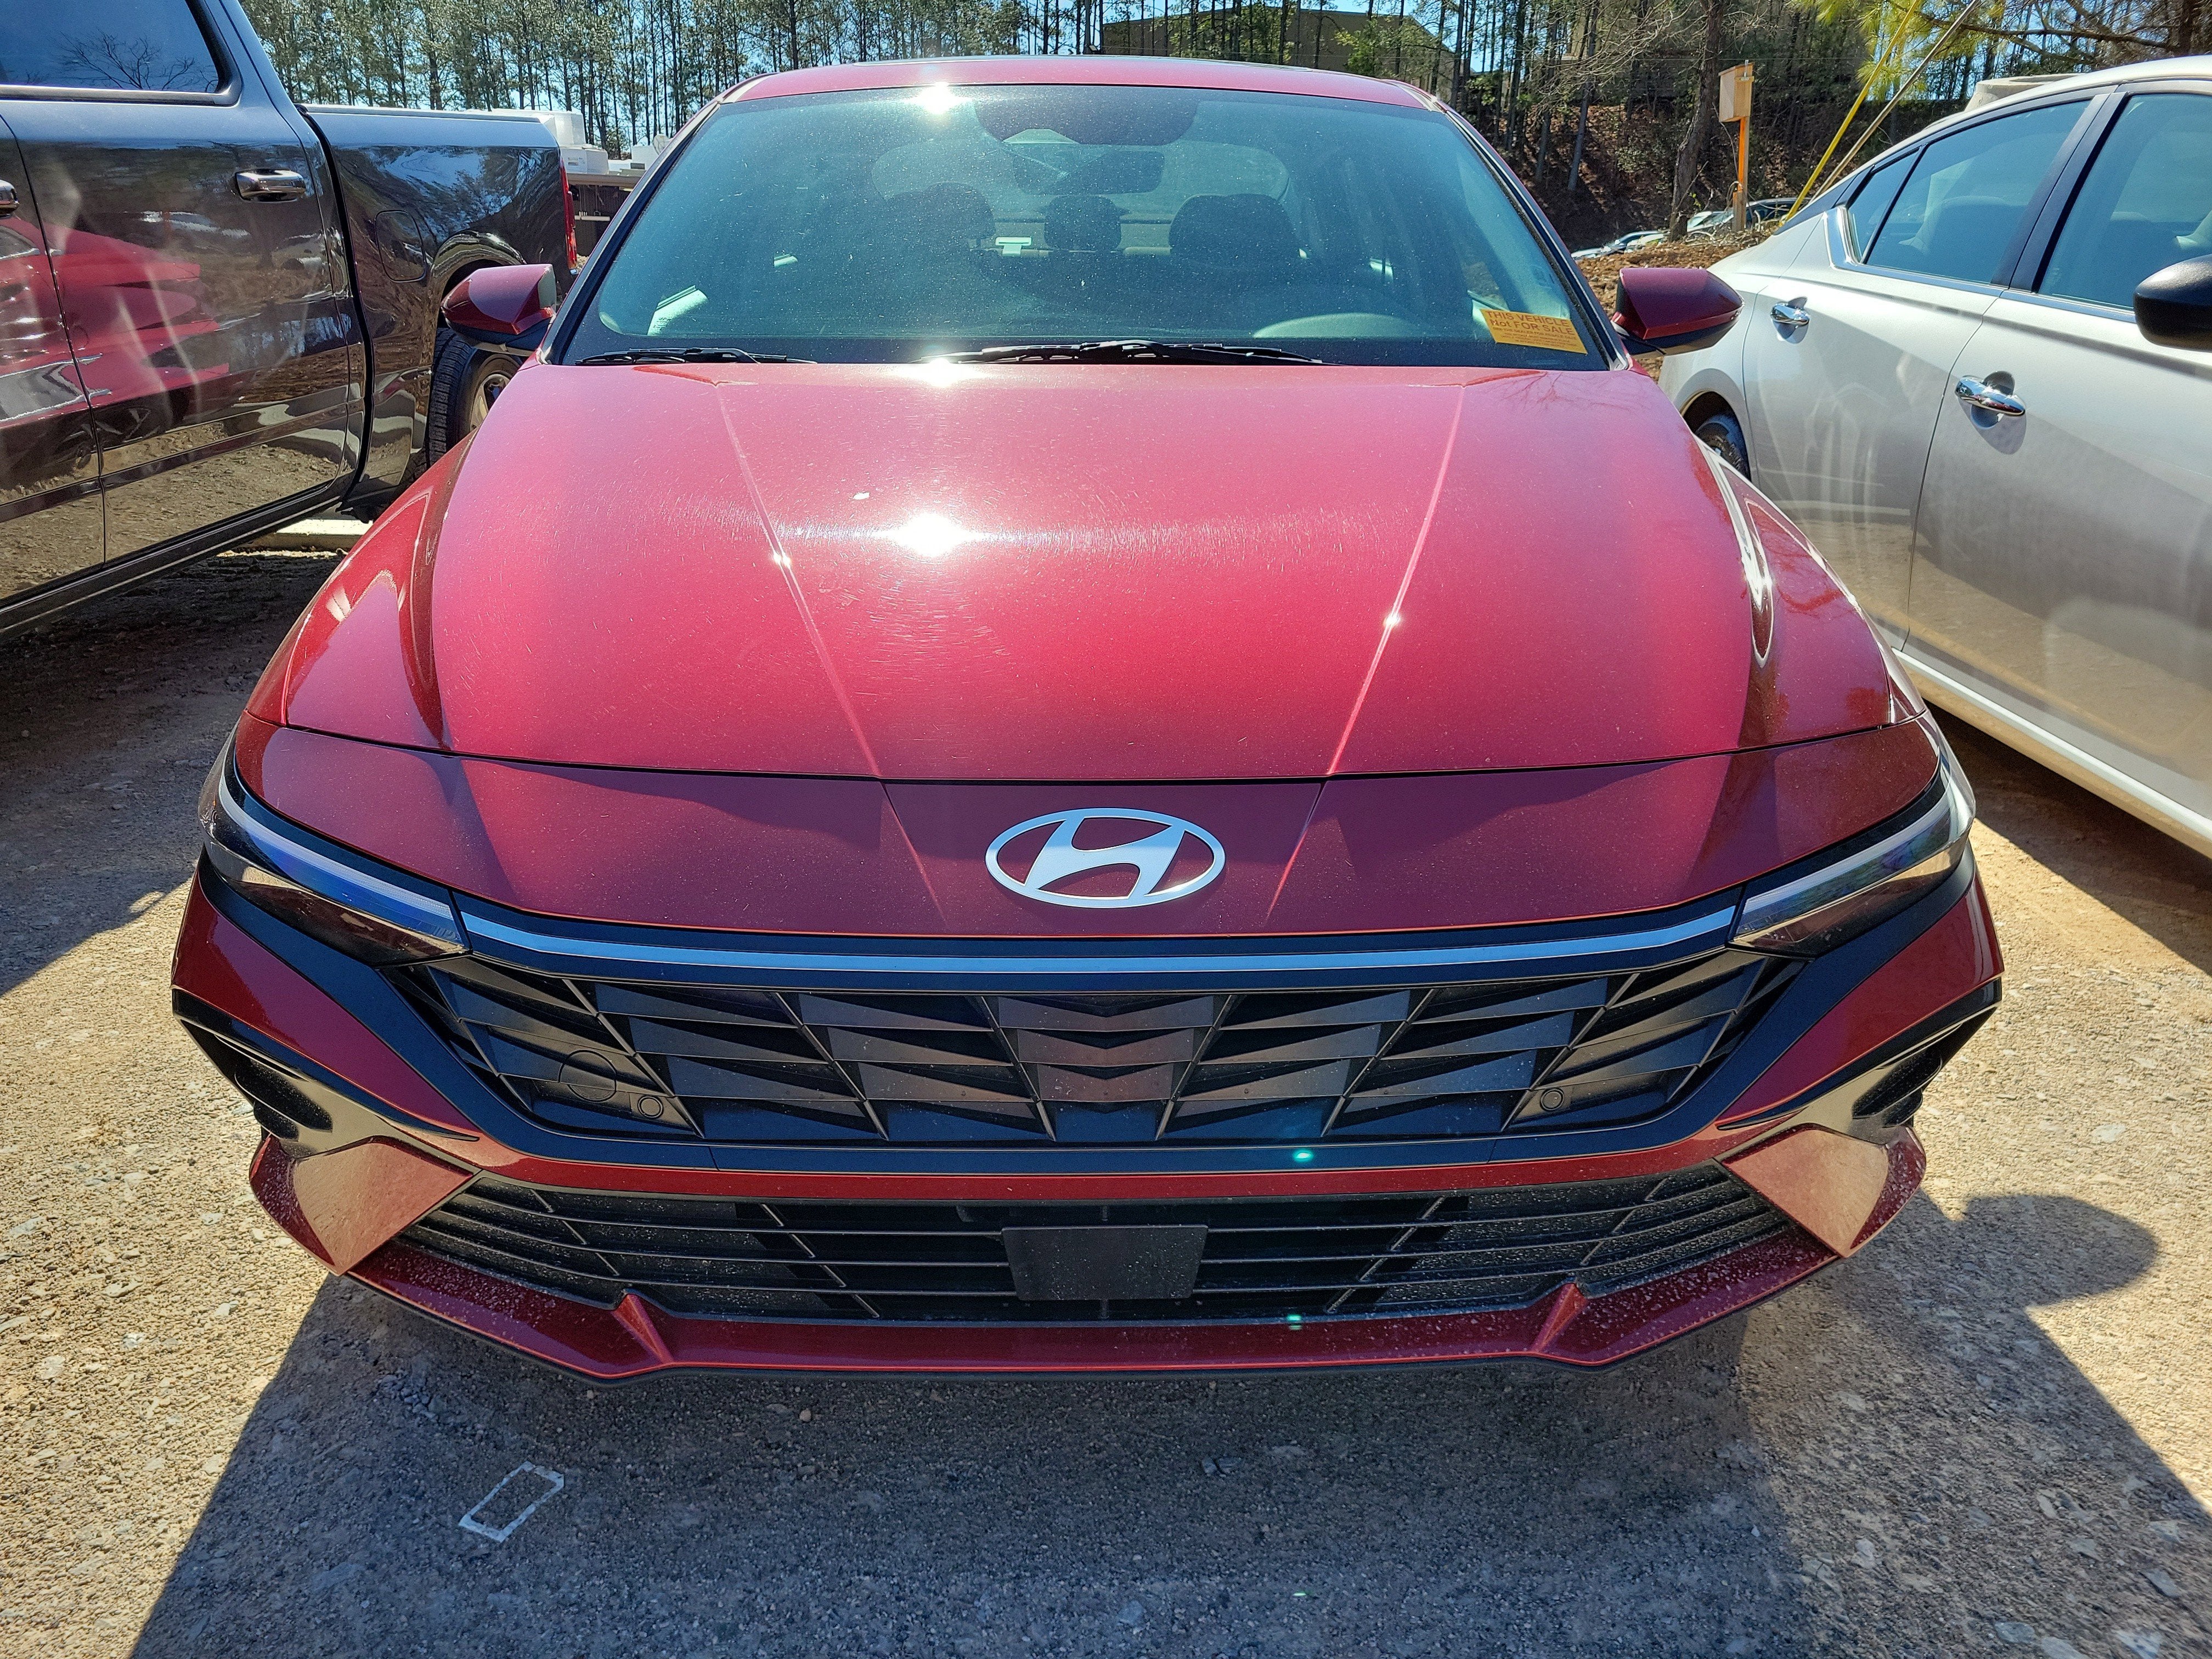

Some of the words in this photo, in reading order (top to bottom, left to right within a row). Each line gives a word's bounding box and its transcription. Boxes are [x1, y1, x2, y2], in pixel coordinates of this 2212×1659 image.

[1485, 311, 1514, 320] THIS
[1517, 314, 1570, 327] VEHICLE
[1514, 321, 1540, 331] FOR
[1542, 325, 1576, 335] SALE
